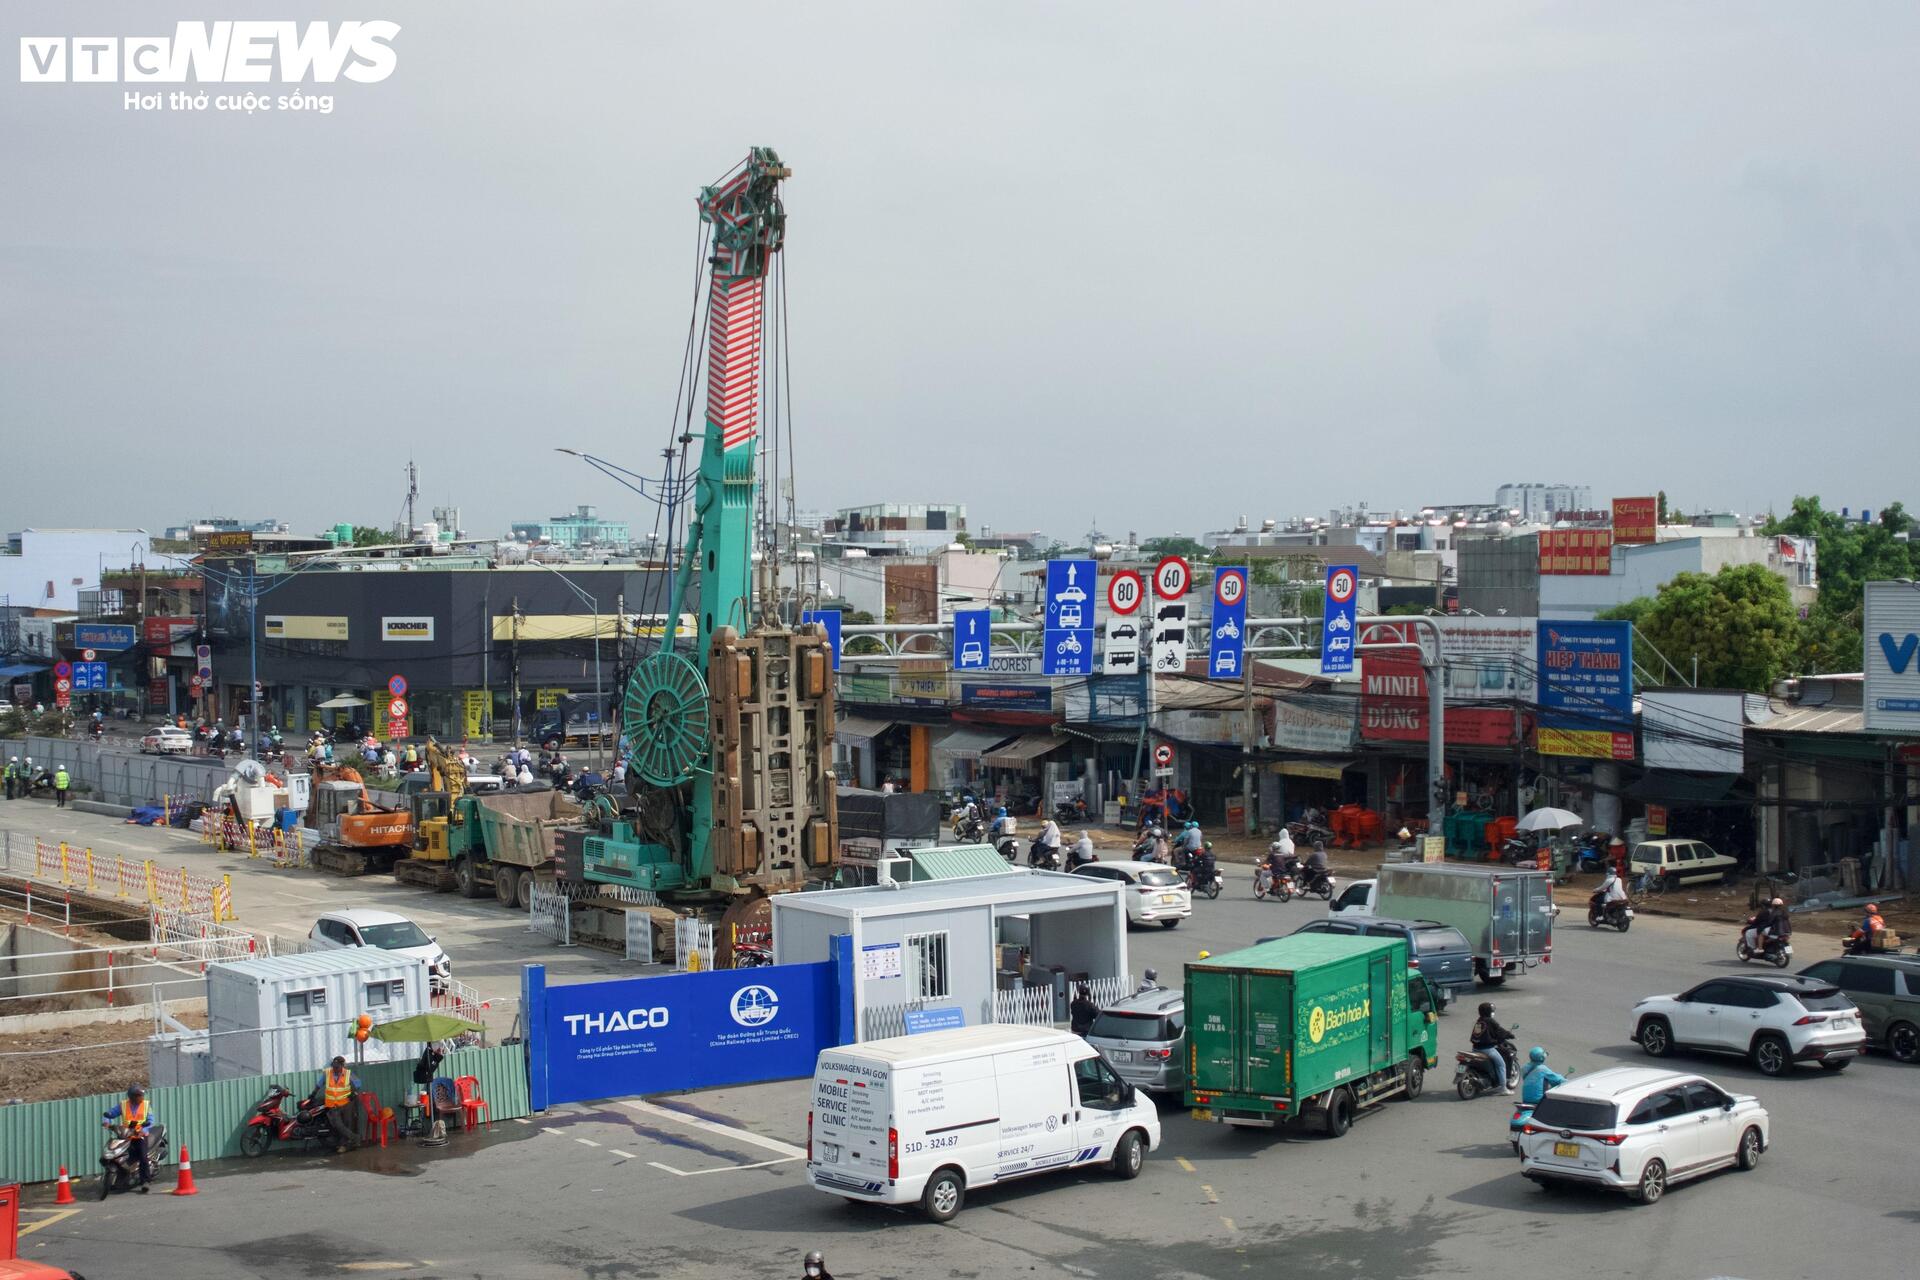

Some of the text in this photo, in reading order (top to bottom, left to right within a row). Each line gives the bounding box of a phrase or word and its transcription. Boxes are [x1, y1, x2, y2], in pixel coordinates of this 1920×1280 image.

[1164, 570, 1180, 588] 60
[1336, 579, 1349, 593] 50
[1118, 583, 1134, 602] 80
[1225, 580, 1238, 596] 50
[1367, 674, 1419, 697] MINH
[1367, 703, 1420, 729] DŨNG
[370, 824, 413, 834] HITACHI
[563, 1006, 669, 1036] THACO
[1325, 1006, 1346, 1030] Bách
[820, 1061, 861, 1074] VOLKSWAGEN
[818, 1083, 849, 1099] MOBILE
[817, 1097, 848, 1113] SERVICE
[822, 1112, 847, 1127] CLINIC
[905, 1141, 923, 1154] 51D
[930, 1135, 959, 1150] 324.87
[997, 1144, 1035, 1159] SERVICE 24/7
[1052, 1155, 1069, 1164] SERVICE
